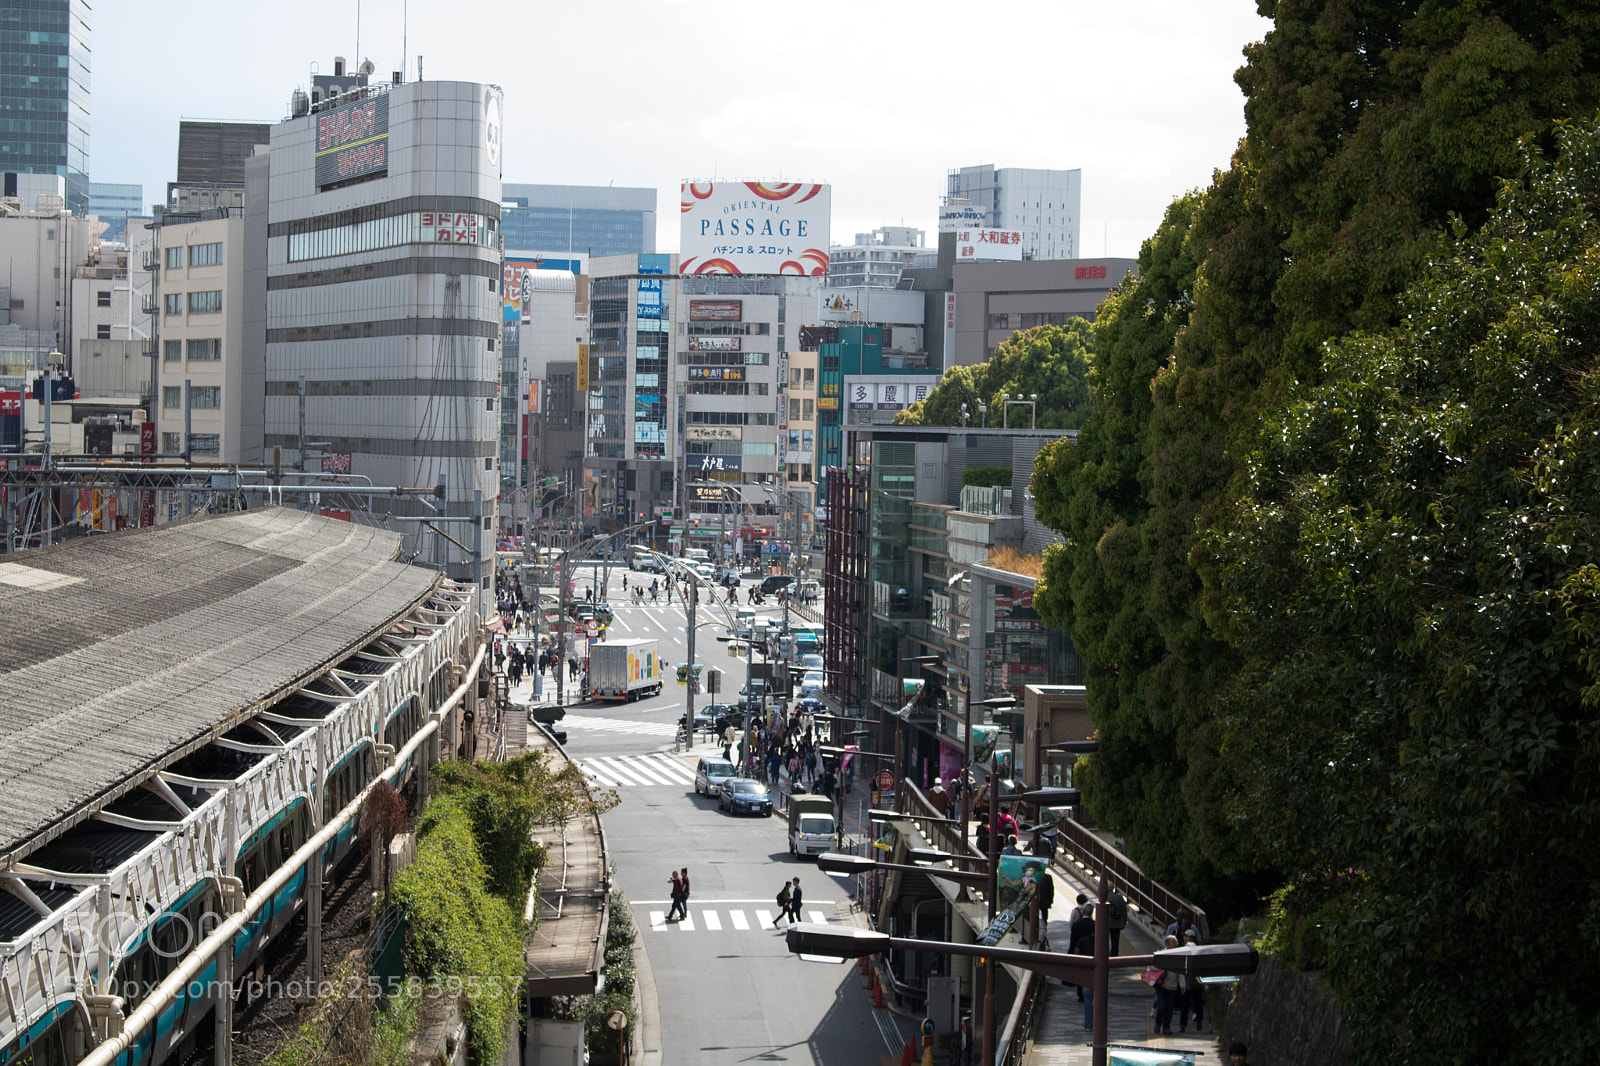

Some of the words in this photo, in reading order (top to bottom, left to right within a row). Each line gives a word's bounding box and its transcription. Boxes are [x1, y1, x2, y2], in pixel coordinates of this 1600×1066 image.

[723, 200, 781, 215] ORIENTAL
[422, 213, 477, 228] ヨドバシ
[700, 218, 808, 237] PASSAGE
[438, 228, 477, 243] カメラ
[957, 231, 970, 242] 大和
[977, 229, 1022, 245] 大和証券
[712, 245, 744, 255] パチンコ
[747, 245, 754, 255] &
[759, 245, 793, 256] スロット
